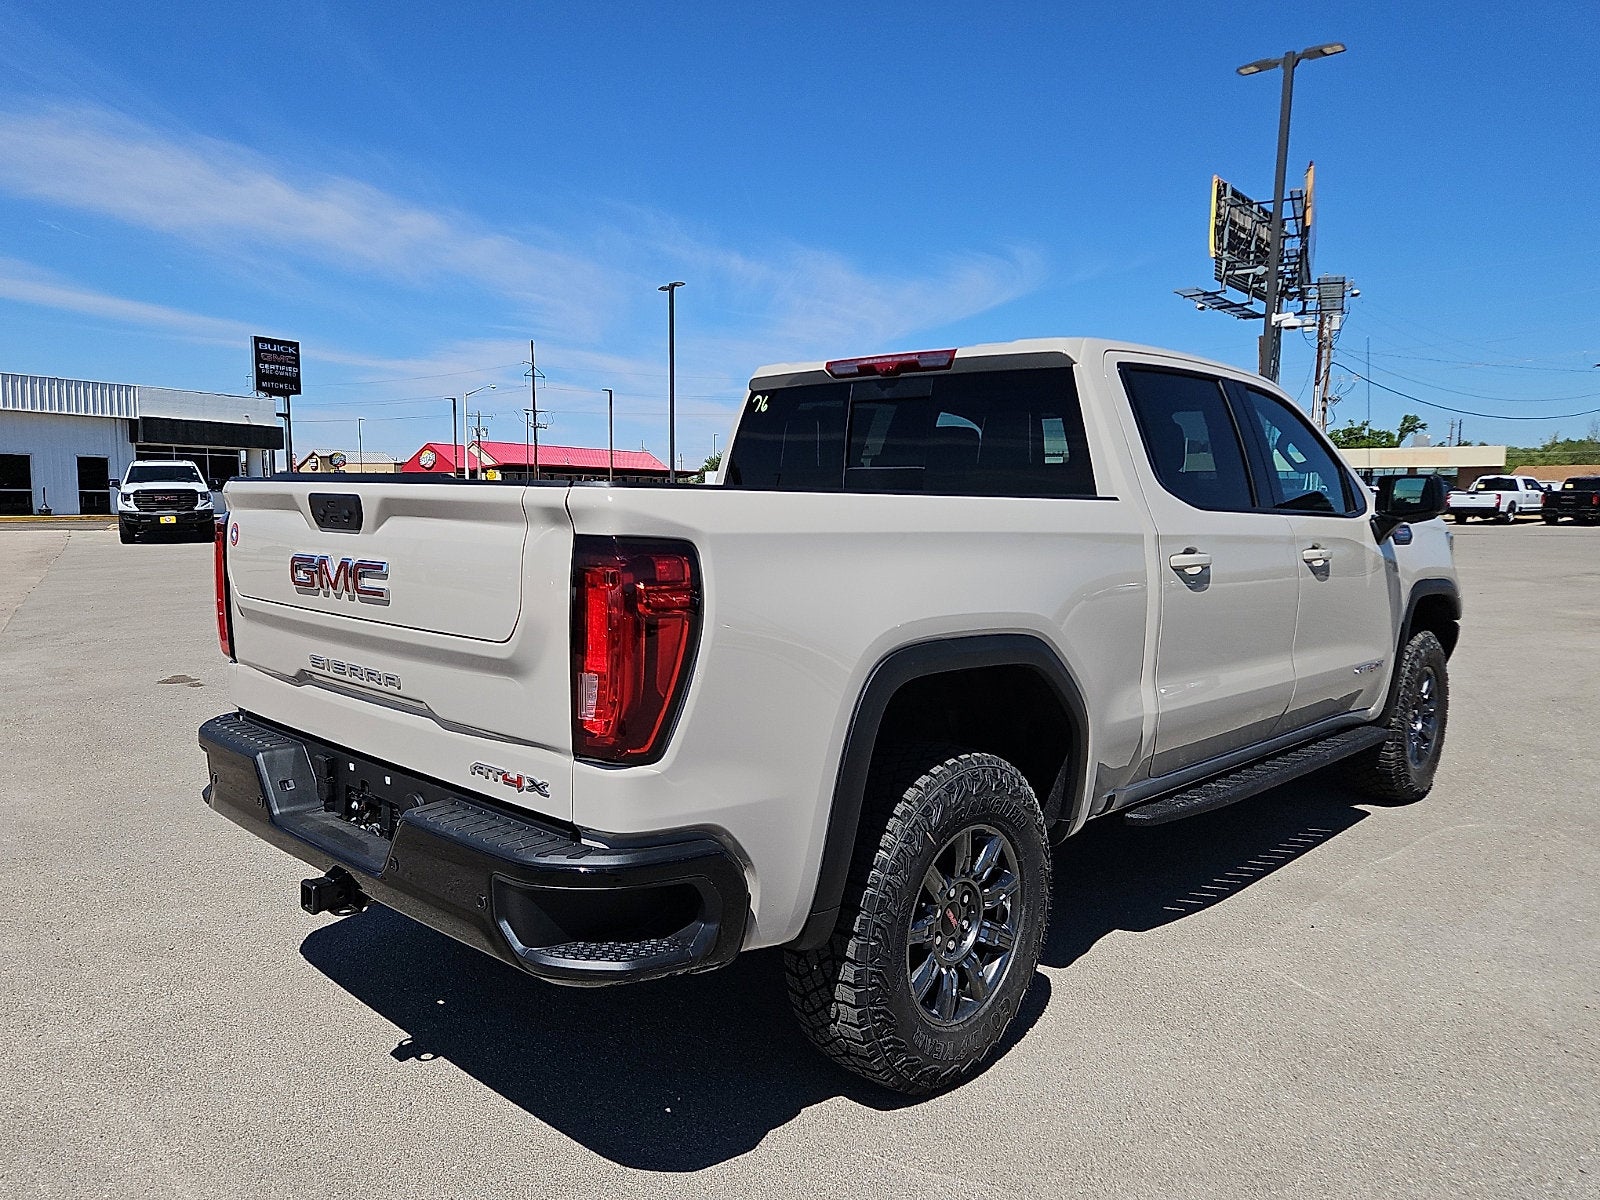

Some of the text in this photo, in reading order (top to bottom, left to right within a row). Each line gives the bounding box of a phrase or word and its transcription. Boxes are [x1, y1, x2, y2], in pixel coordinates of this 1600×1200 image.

[259, 343, 297, 354] BUICK
[260, 353, 296, 364] GMC
[259, 363, 298, 373] CERTIFIED
[261, 381, 297, 391] MITCHELL
[289, 553, 390, 606] GMC
[309, 654, 402, 691] SIERRA
[469, 761, 551, 799] AT4X
